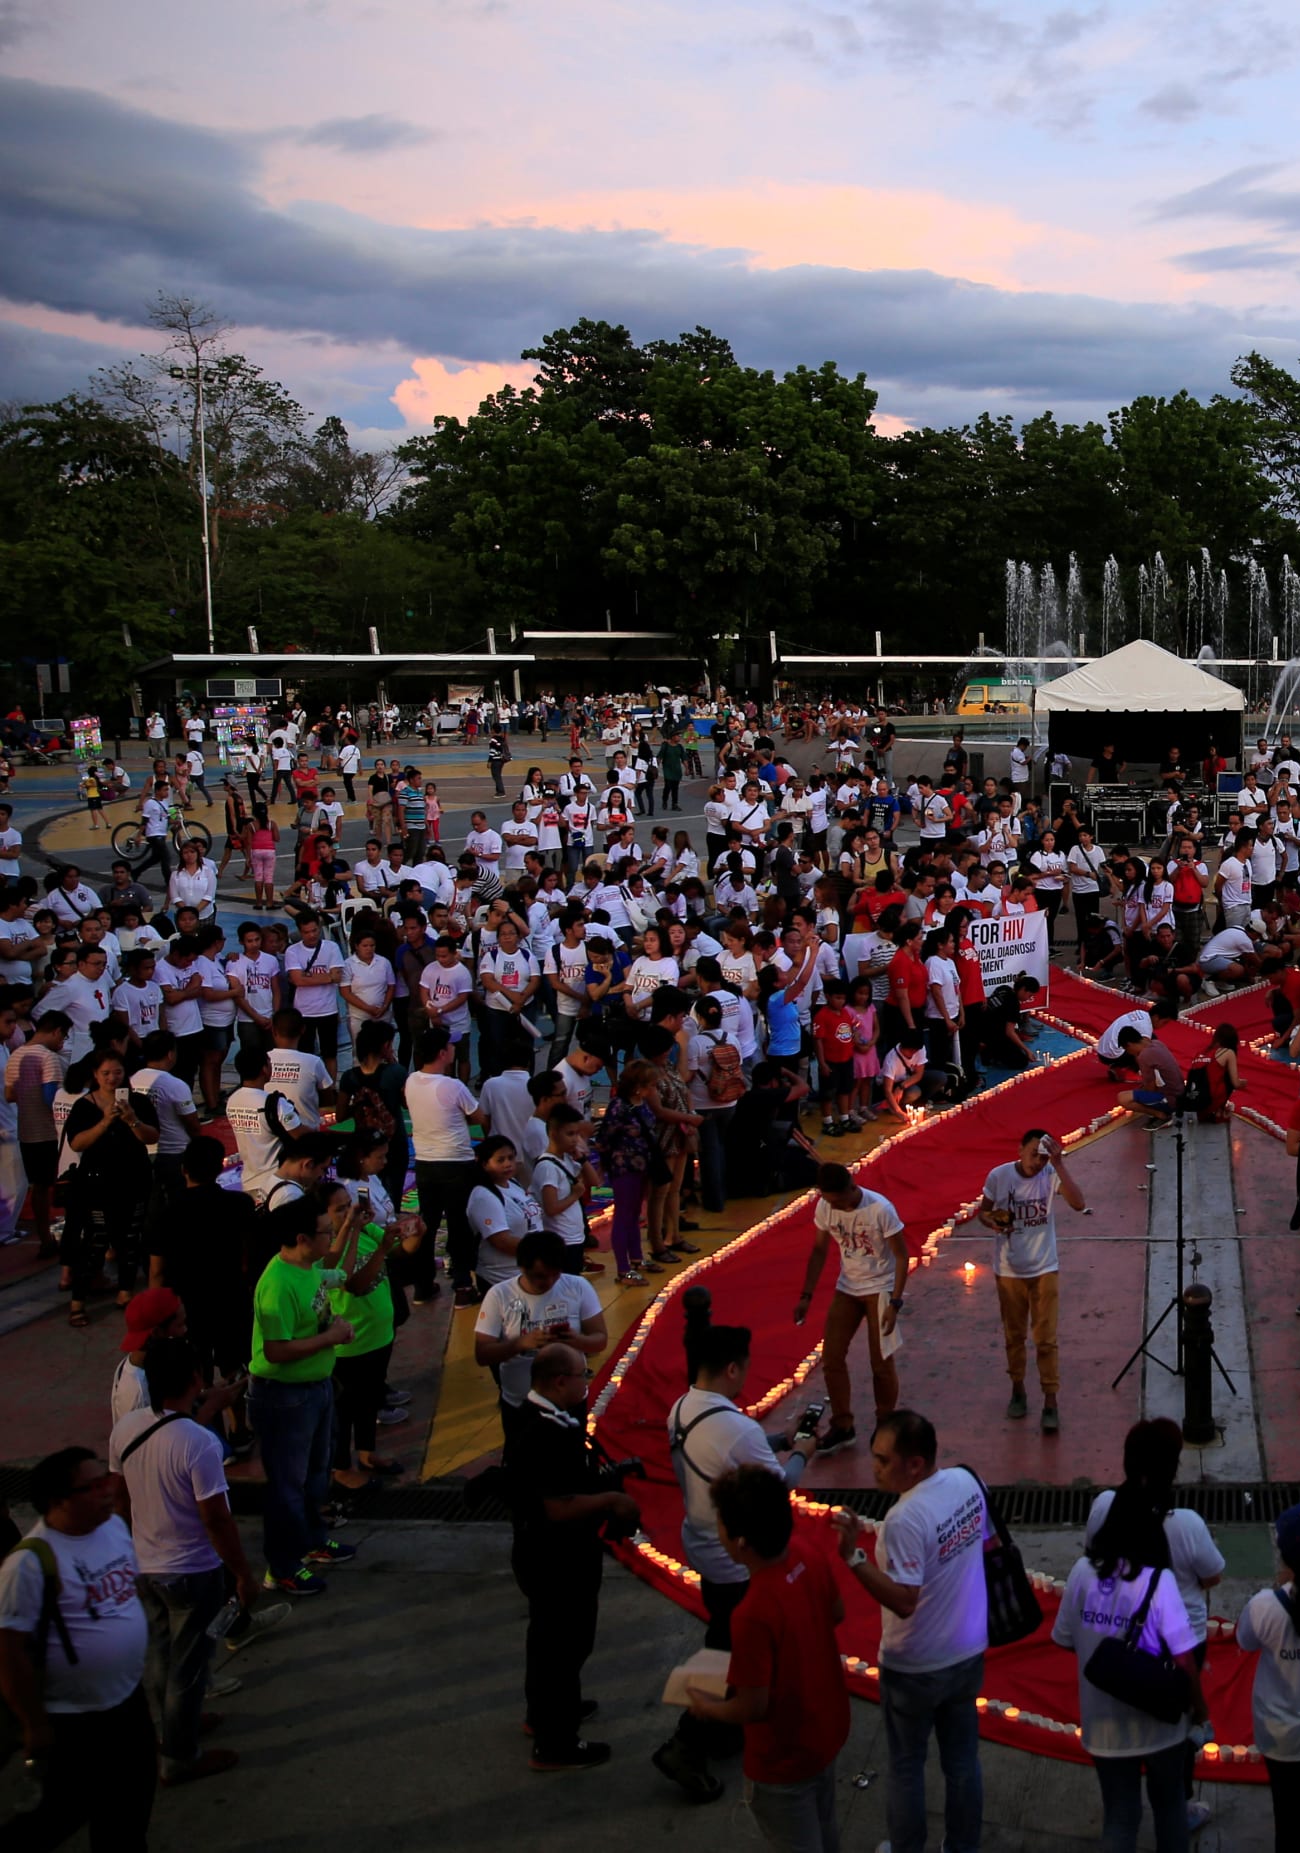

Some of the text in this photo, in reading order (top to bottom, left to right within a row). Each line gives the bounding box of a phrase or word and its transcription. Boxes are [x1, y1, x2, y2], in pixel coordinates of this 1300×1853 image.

[971, 919, 1025, 945] FOR HIV
[977, 947, 995, 960] ICAL
[998, 941, 1036, 958] DIAGNOSIS
[982, 960, 1005, 973] MENT
[983, 974, 1018, 987] emnatio
[1024, 1217, 1048, 1227] HOUR
[938, 1525, 956, 1544] Get
[939, 1515, 981, 1557] #PUSHP
[1080, 1609, 1131, 1630] EZON CIT
